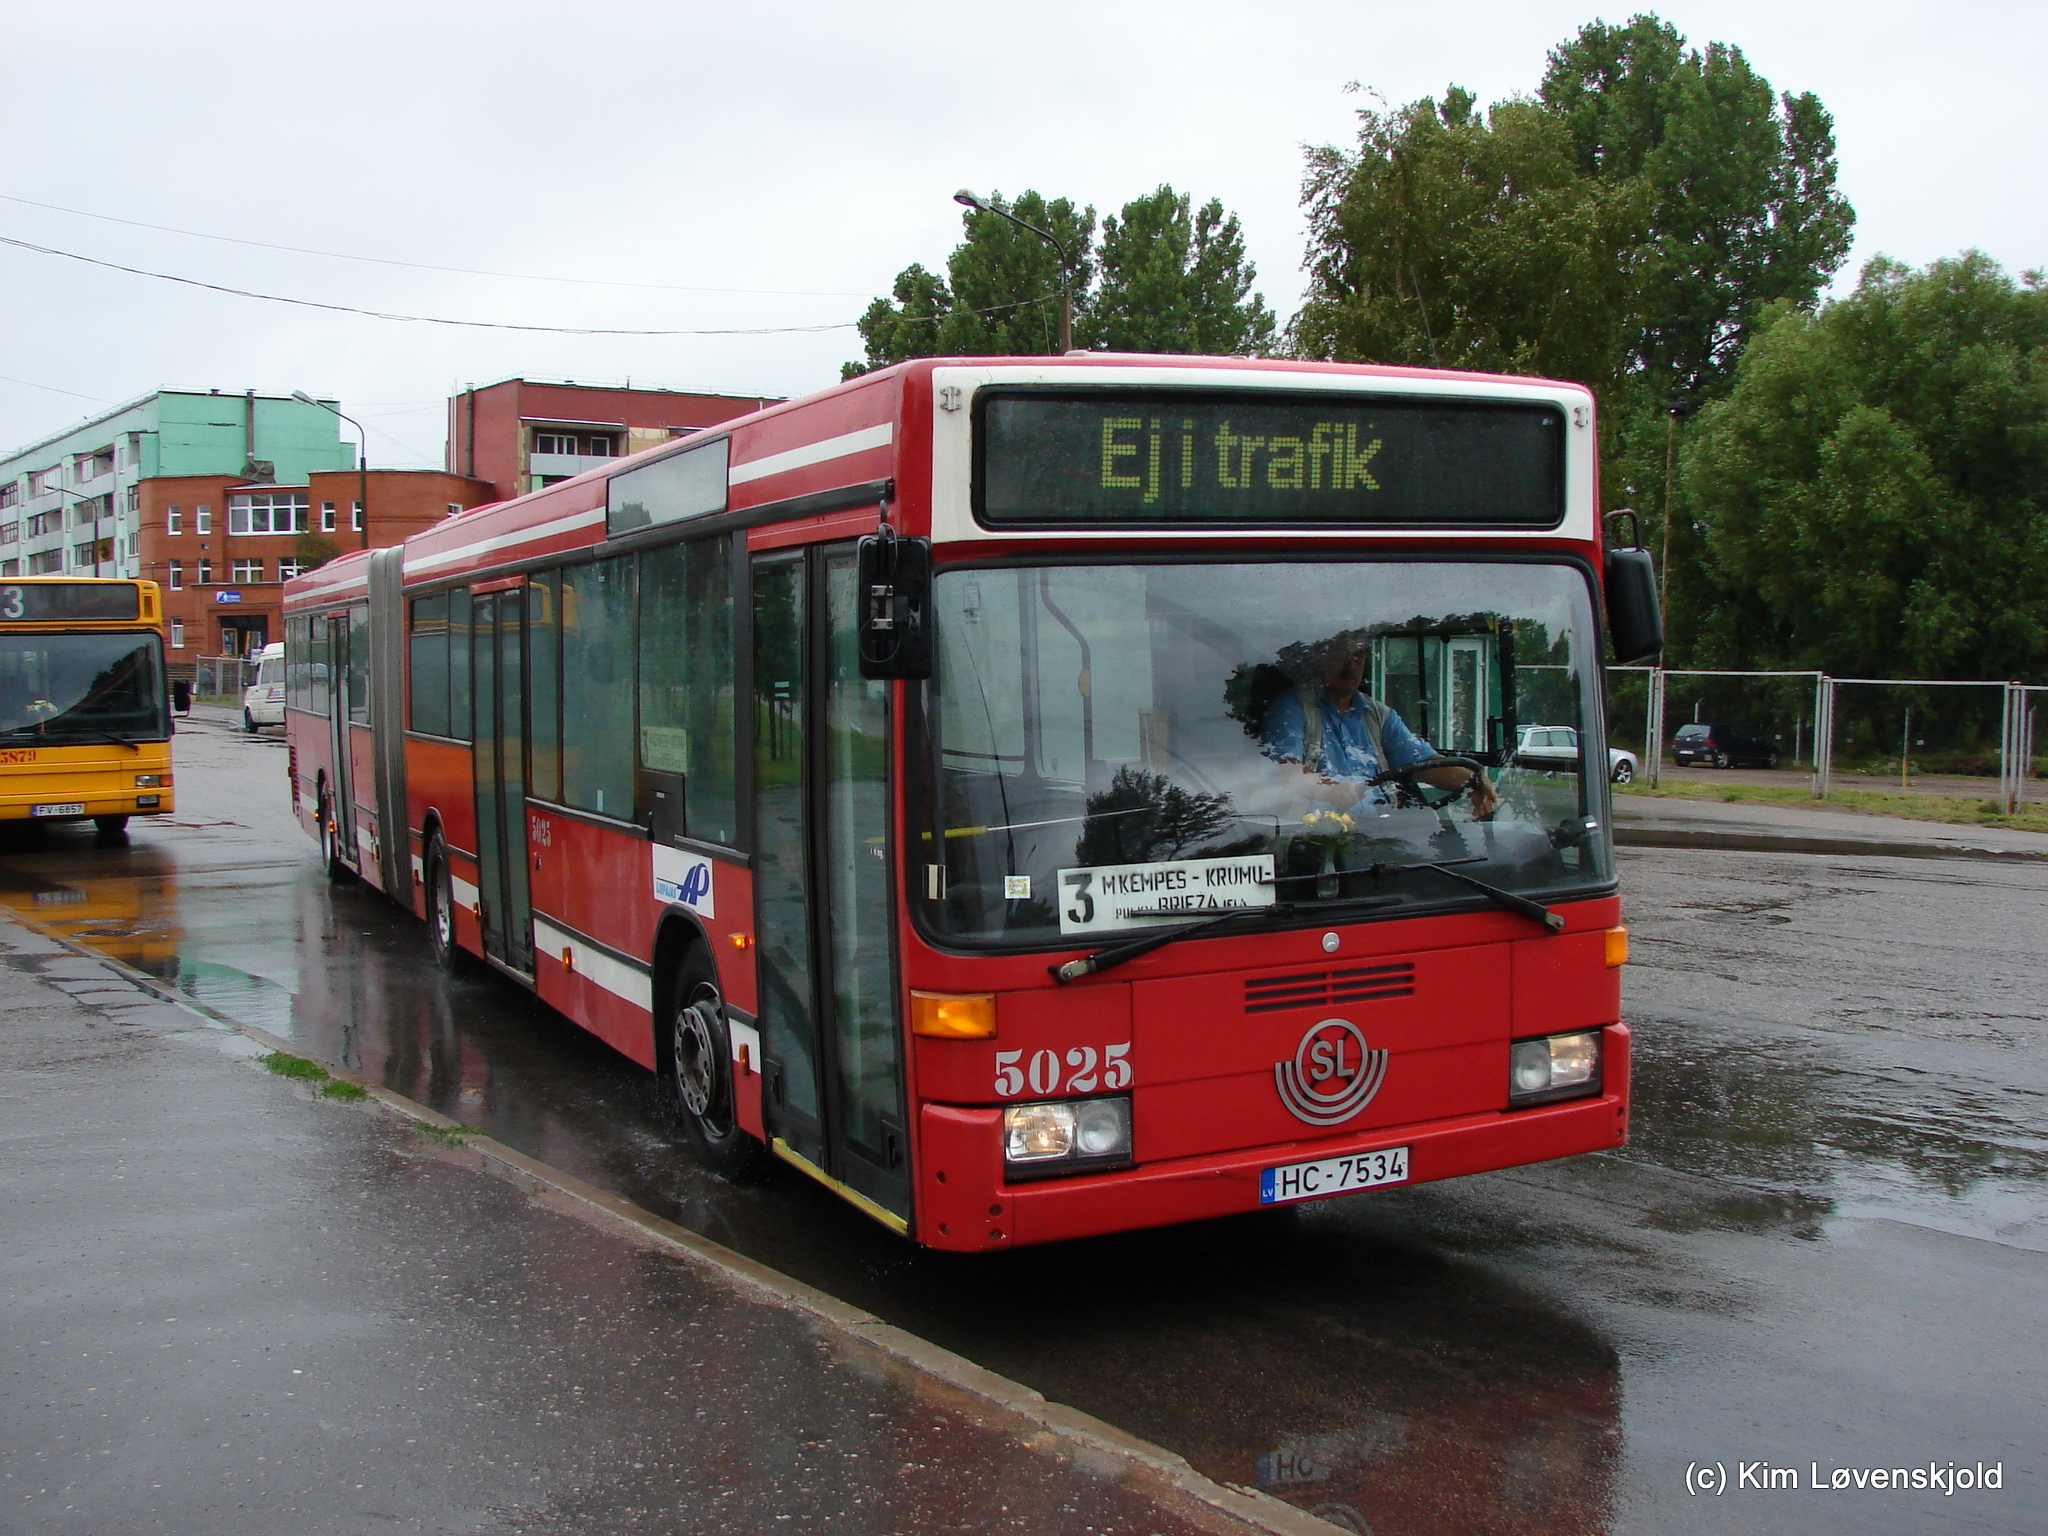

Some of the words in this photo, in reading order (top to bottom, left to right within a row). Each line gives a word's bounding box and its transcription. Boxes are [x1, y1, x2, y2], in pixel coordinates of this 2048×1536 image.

[1101, 417, 1160, 503] Ej
[1182, 418, 1193, 488] i
[1214, 420, 1382, 490] trafik
[3, 585, 24, 618] 3
[1064, 873, 1095, 923] 3
[994, 1040, 1132, 1096] 5025
[1310, 1039, 1355, 1081] SL
[1262, 1187, 1274, 1198] LV
[1281, 1151, 1404, 1197] HC-7534
